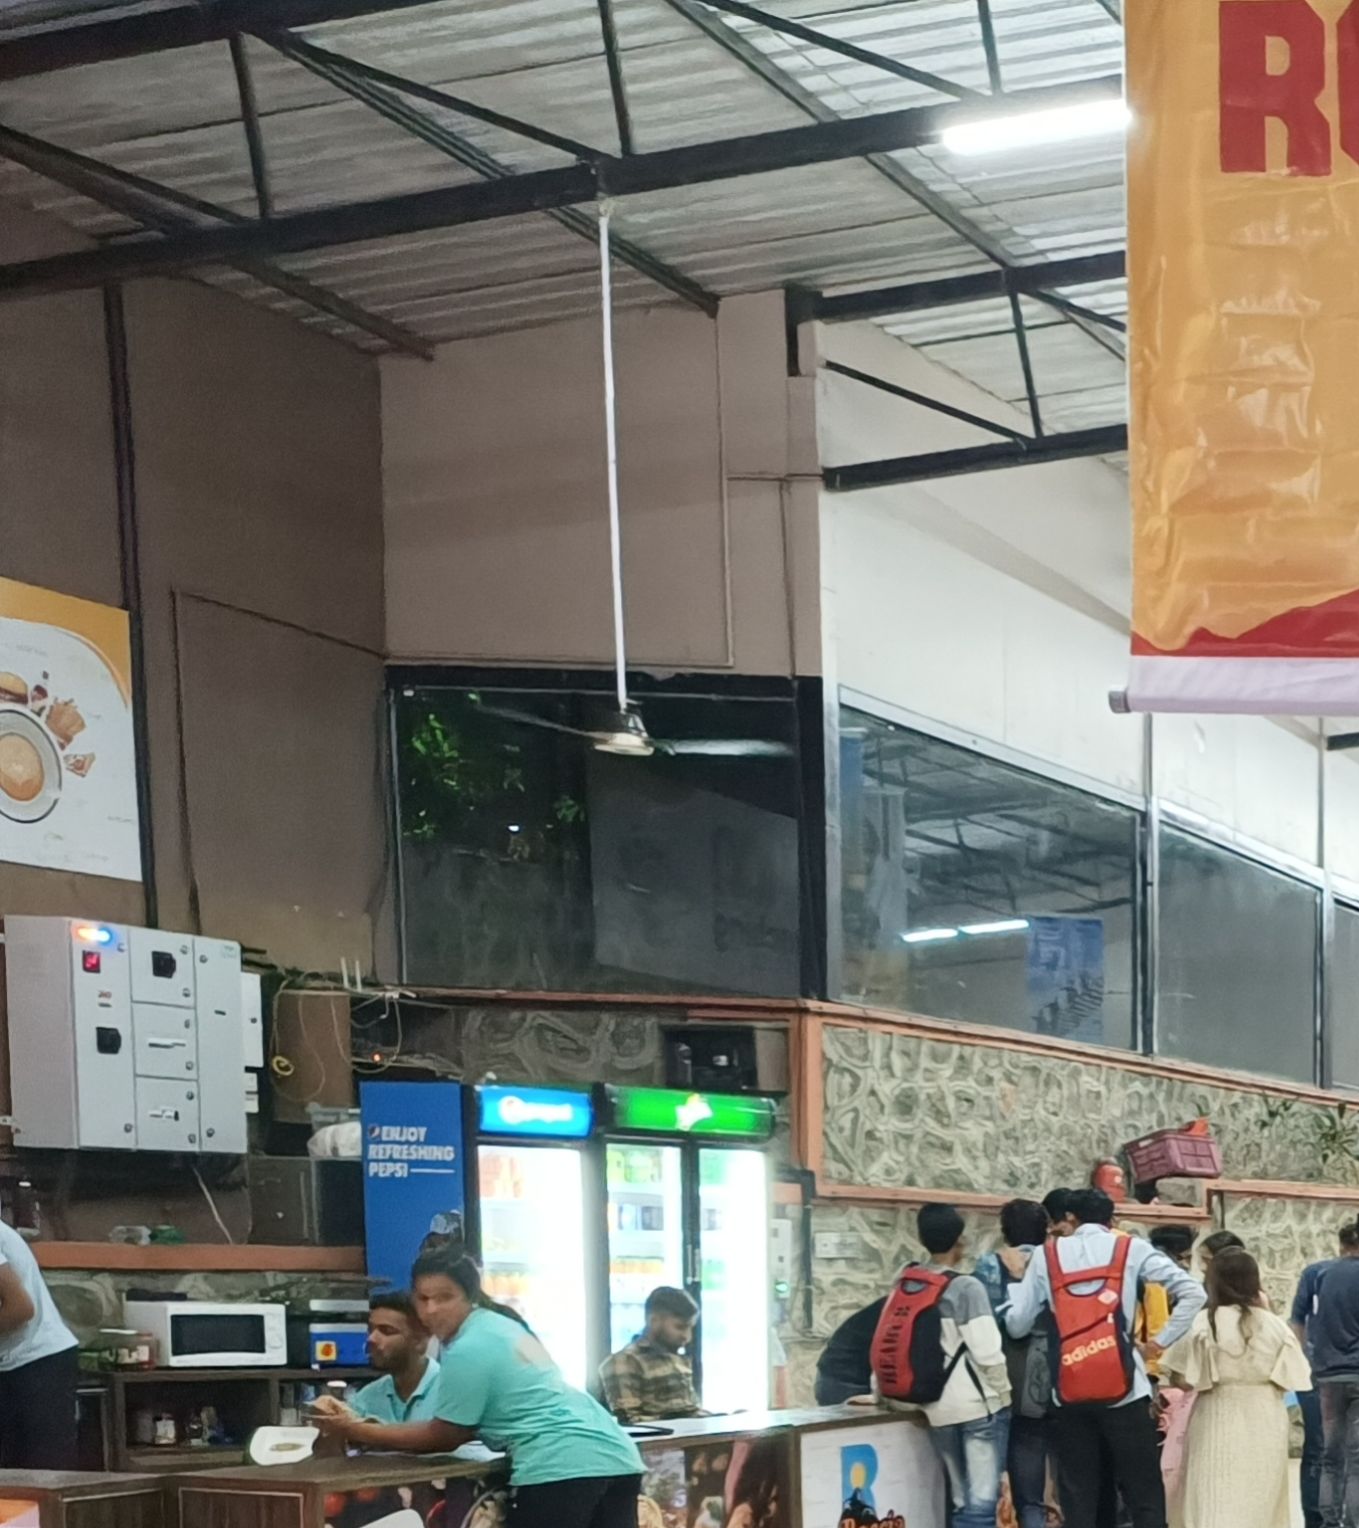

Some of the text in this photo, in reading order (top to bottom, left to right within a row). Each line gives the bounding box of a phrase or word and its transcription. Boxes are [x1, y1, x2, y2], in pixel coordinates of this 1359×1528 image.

[381, 1125, 427, 1142] ENJOY
[367, 1144, 455, 1161] REFRESHING
[368, 1162, 408, 1178] PEPSI
[1061, 1335, 1116, 1366] adidas
